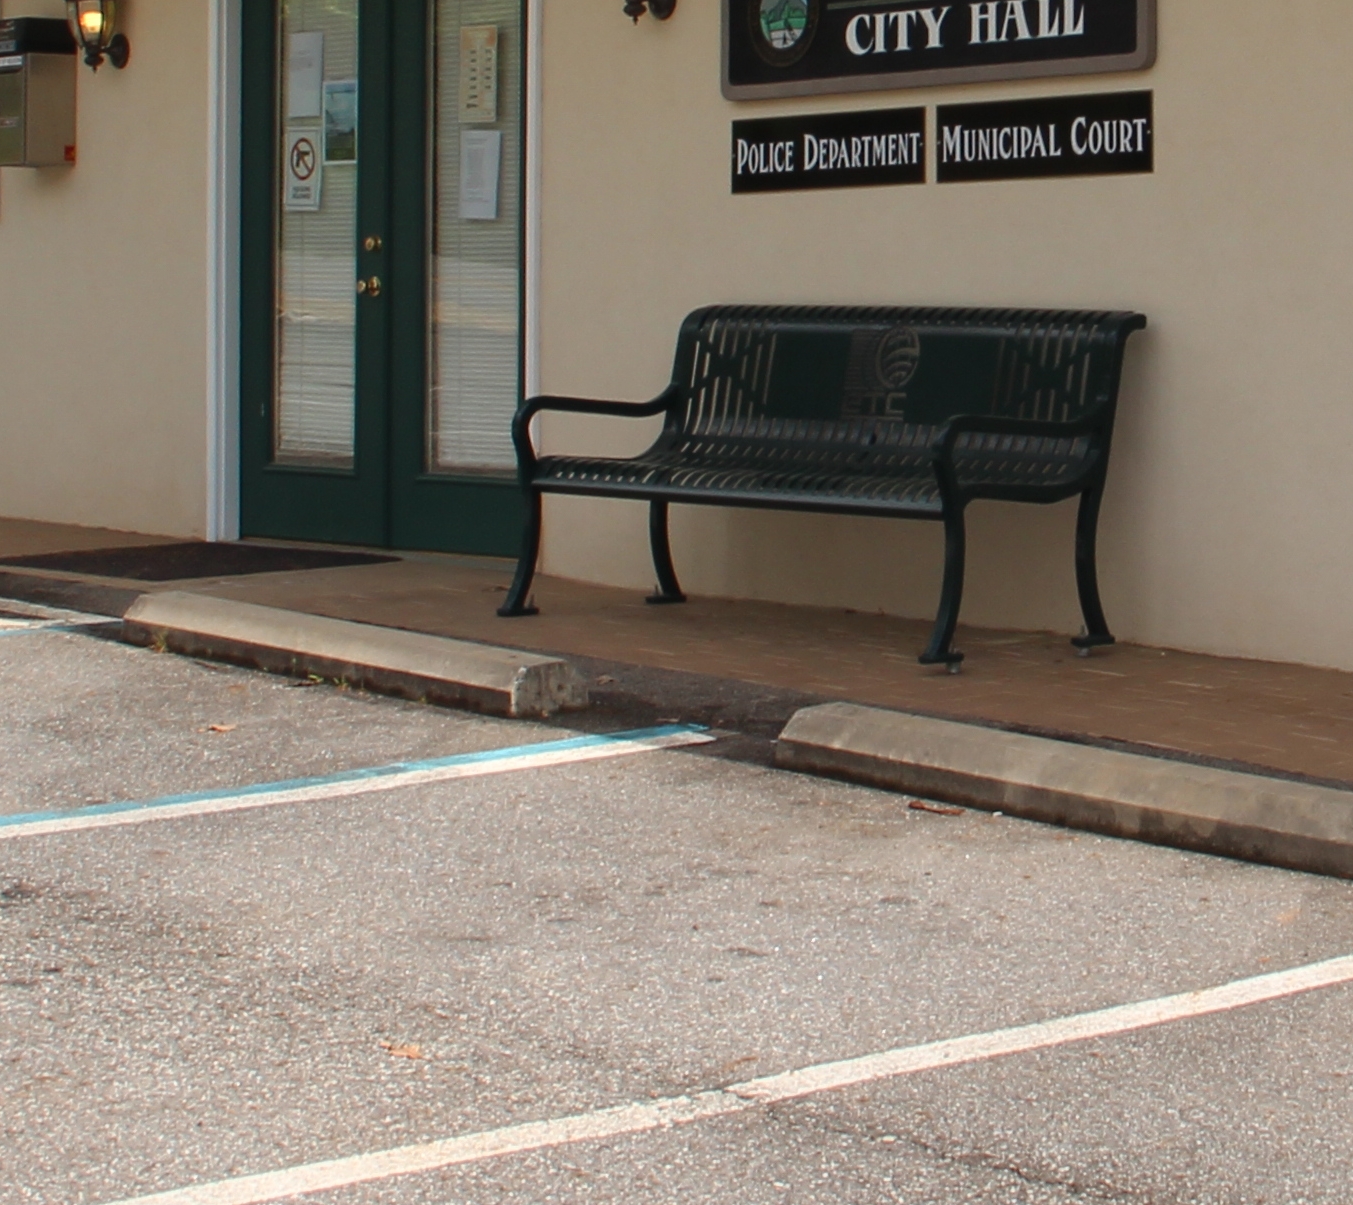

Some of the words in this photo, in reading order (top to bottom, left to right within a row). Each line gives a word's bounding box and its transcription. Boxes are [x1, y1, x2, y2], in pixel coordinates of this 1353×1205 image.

[844, 5, 952, 56] CITY
[736, 138, 795, 175] POLICE
[802, 132, 922, 172] DEPARTMENT
[941, 123, 1062, 164] MUNICIPAL
[1070, 116, 1148, 157] COURT
